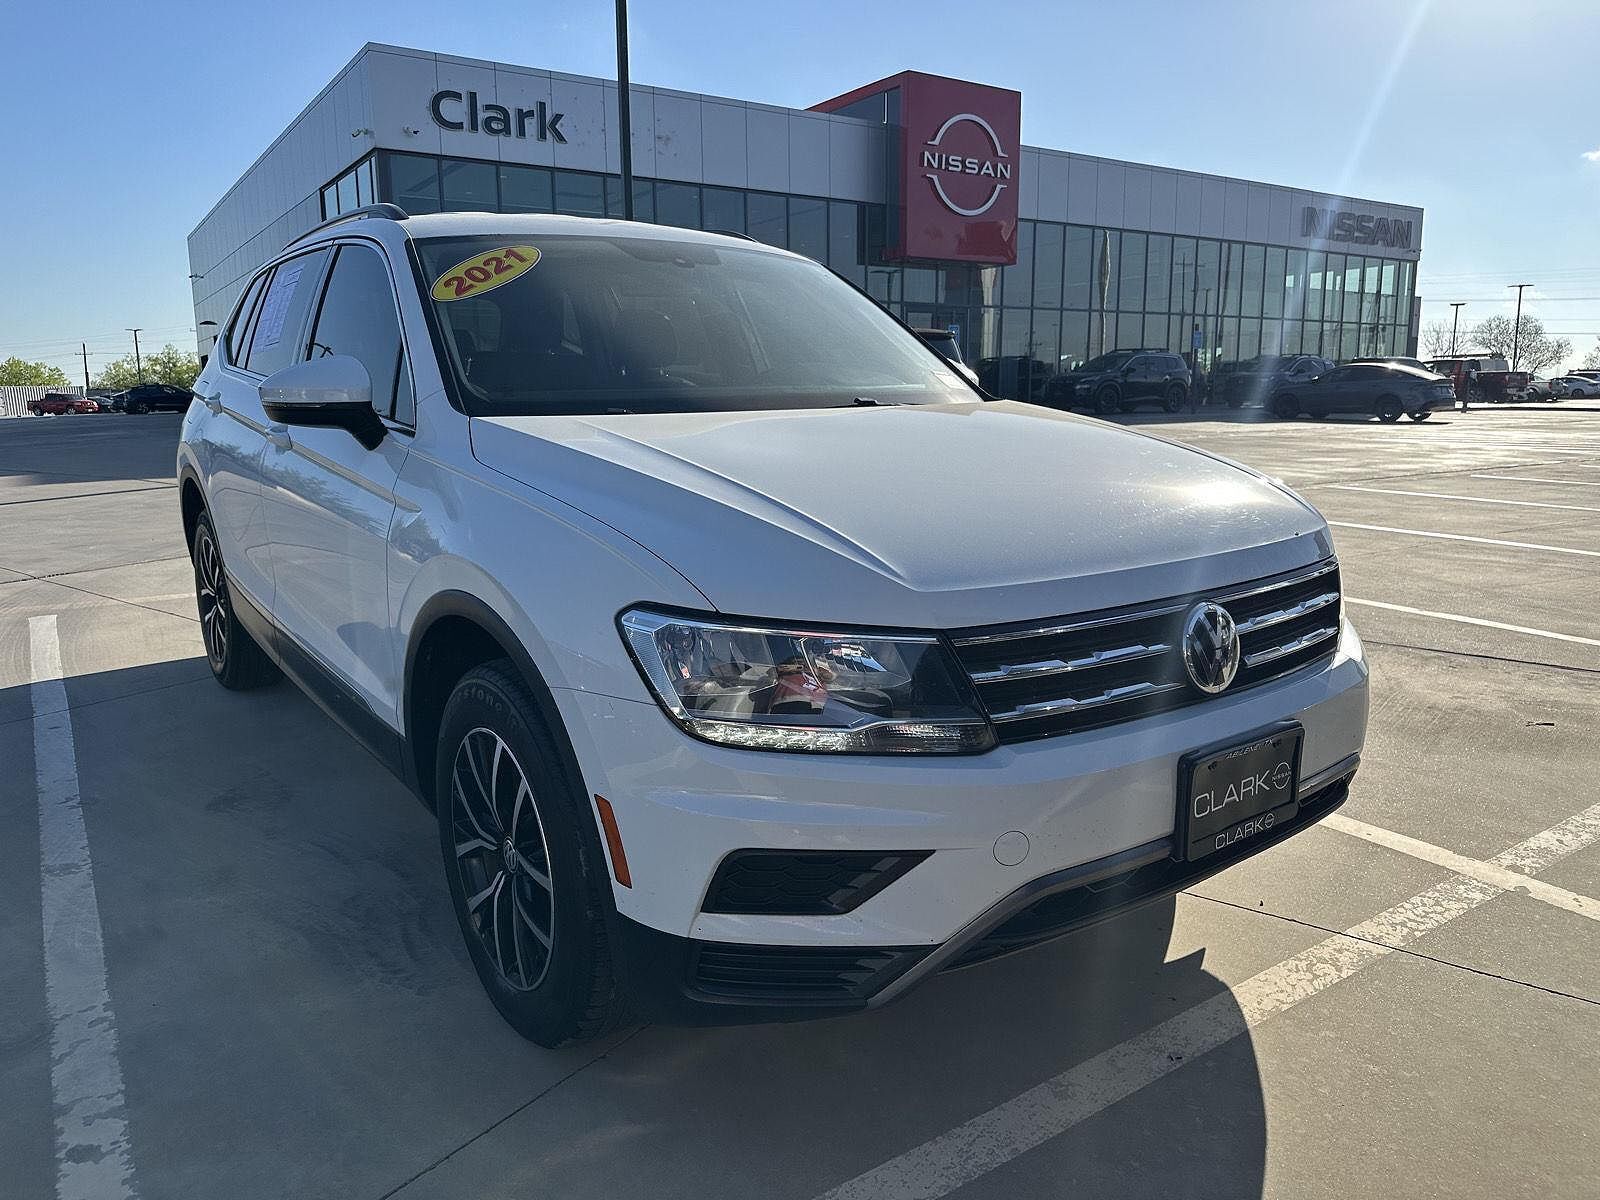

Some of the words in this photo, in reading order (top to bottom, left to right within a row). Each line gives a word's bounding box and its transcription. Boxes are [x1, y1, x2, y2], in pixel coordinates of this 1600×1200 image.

[430, 89, 567, 144] Clark
[923, 150, 1011, 179] NISSAN
[1301, 206, 1412, 249] NISSAN
[443, 249, 528, 297] 2021
[1194, 769, 1270, 818] CLARK
[1215, 817, 1264, 850] CLARK
